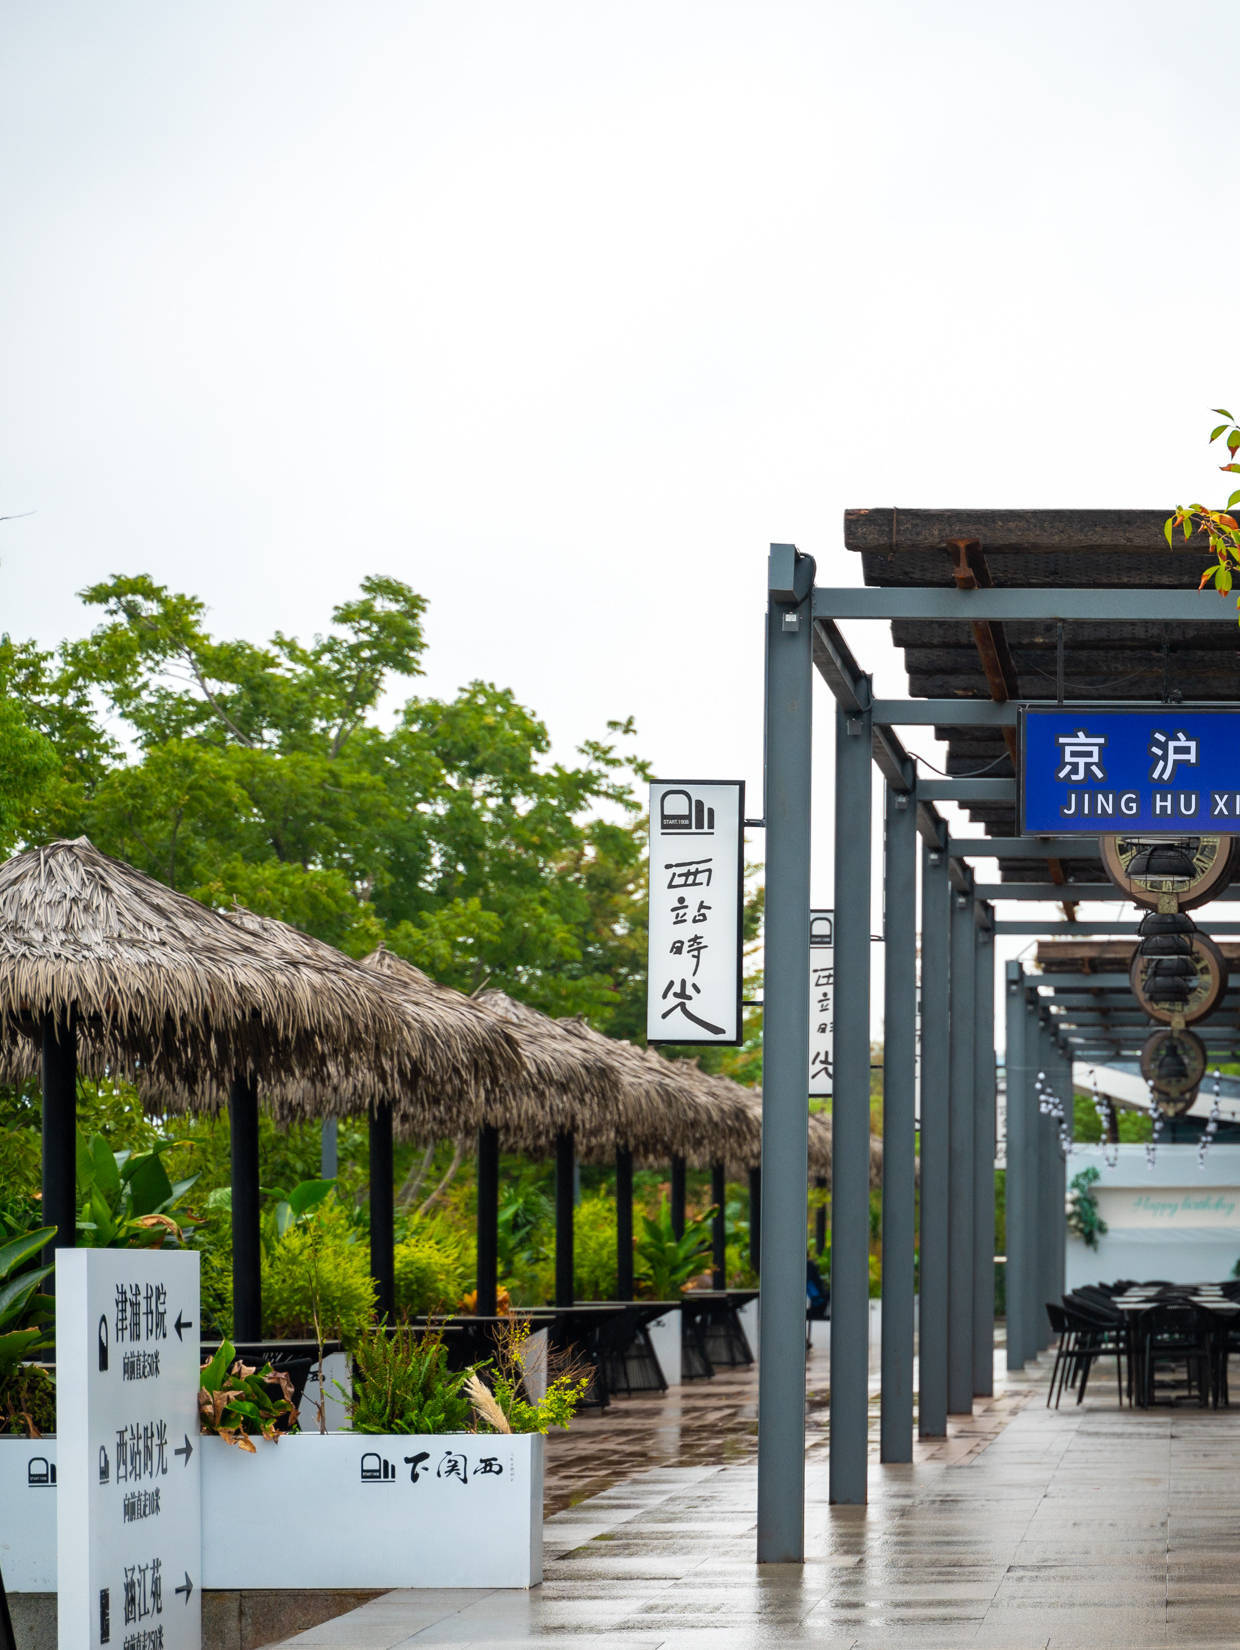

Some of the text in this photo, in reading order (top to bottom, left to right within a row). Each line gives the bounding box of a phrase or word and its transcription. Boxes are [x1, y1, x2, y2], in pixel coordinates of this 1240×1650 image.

[1063, 793, 1137, 815] JING
[1156, 794, 1196, 815] HU
[115, 1283, 167, 1343] 津浦书院
[116, 1420, 168, 1484] 西站时光
